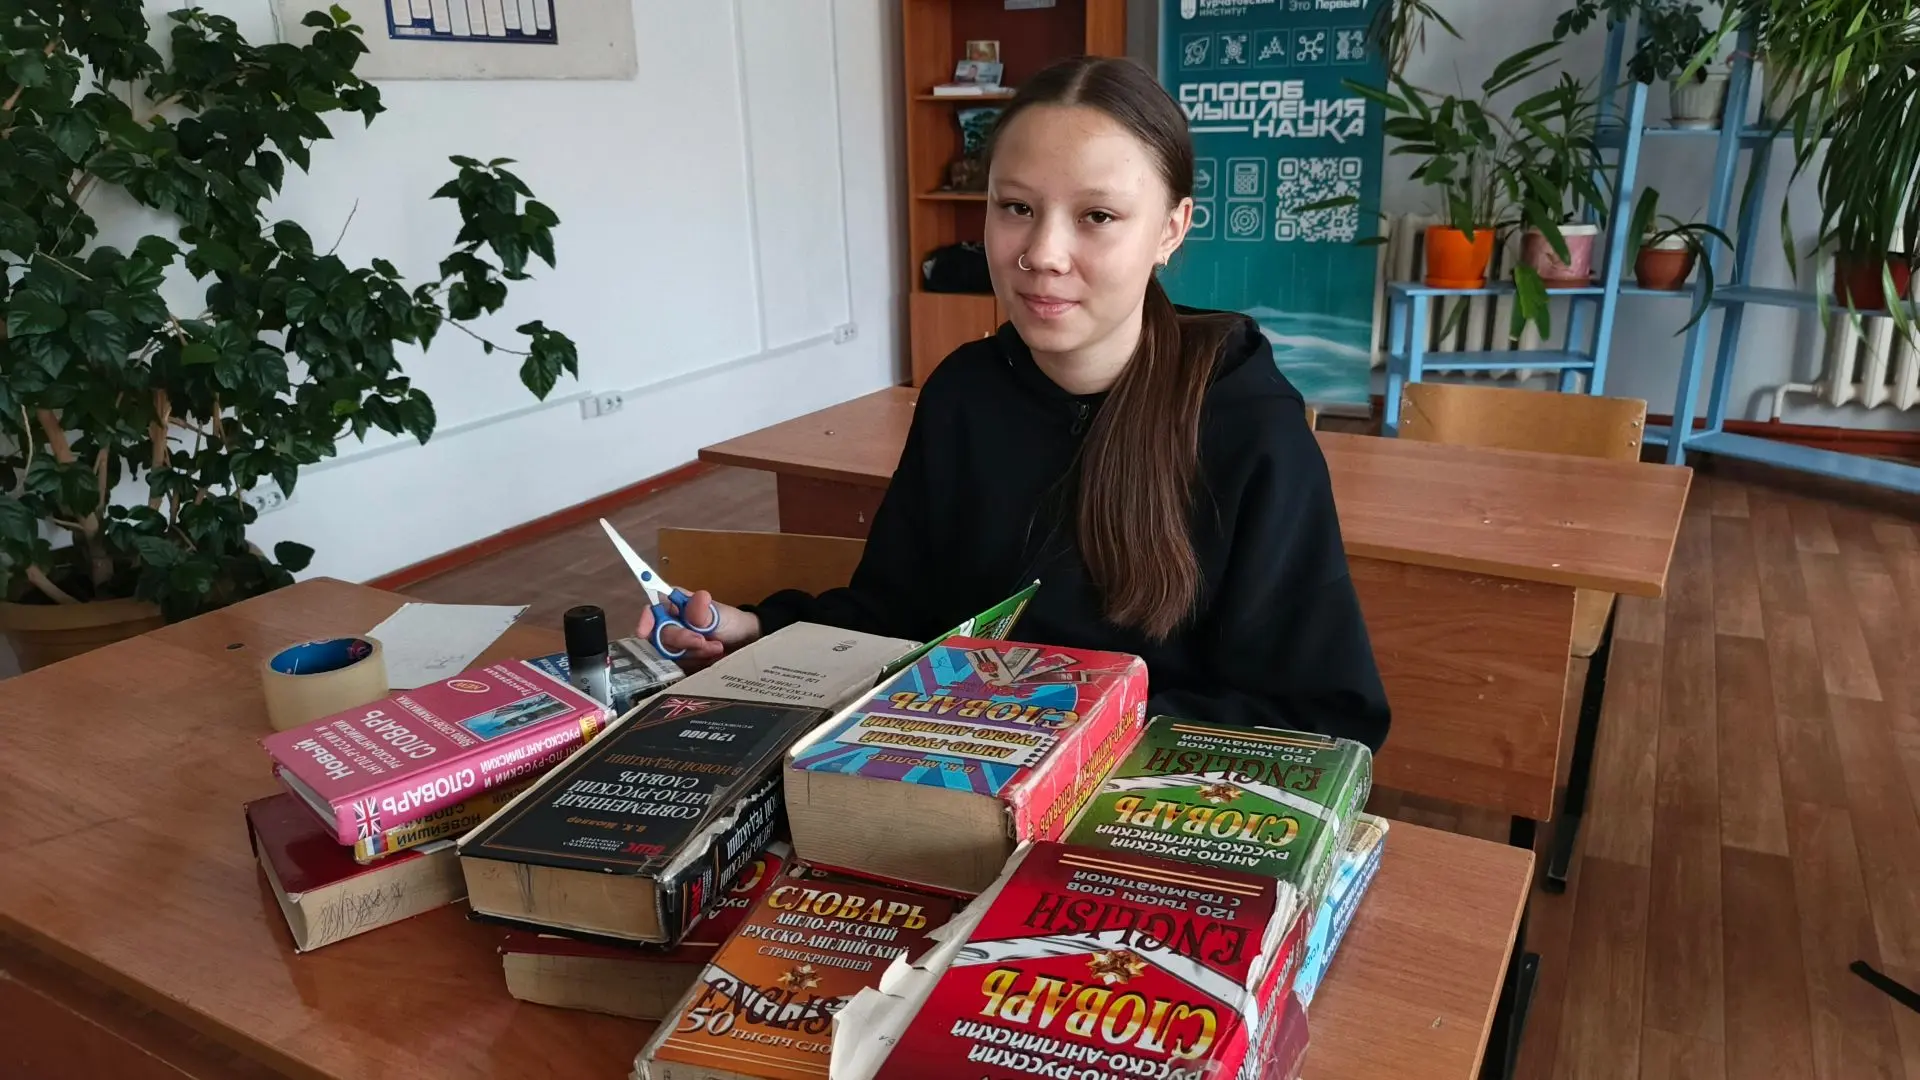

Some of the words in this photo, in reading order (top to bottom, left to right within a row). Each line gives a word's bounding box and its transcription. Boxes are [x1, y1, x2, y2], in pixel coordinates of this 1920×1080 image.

[1179, 80, 1304, 102] СПОСОБ
[1180, 98, 1366, 121] МЫШЛЕНИЯ
[1253, 118, 1365, 143] НАУКА
[887, 690, 1080, 731] СЛОВАРЬ
[331, 719, 406, 769] РУССКО-АНГЛИЙСКИЙ
[360, 709, 437, 759] СЛОВАРЬ
[679, 728, 707, 741] 000
[707, 730, 736, 743] 120
[858, 730, 1020, 759] АНГЛО-РУССКИЙ
[860, 715, 1044, 746] РУССКО-АНГЛИЙСКИЙ
[1180, 733, 1304, 755] грамматикой
[322, 728, 386, 775] АНГЛО-РУССКИЙ
[480, 727, 581, 774] РУССКО-АНГЛИЙСКИЙ
[1176, 740, 1218, 752] слов
[1220, 745, 1276, 763] тысяч
[1280, 753, 1313, 764] 120
[604, 752, 677, 771] РЕДАКЦИИ
[866, 752, 942, 770] МЮЛЛЕР
[1142, 747, 1326, 791] ENGLISH
[382, 768, 475, 816] СЛОВАРЬ
[484, 778, 492, 788] И
[568, 780, 713, 804] АНГЛО-РУССКИЙ
[619, 771, 701, 789] СЛОВАРЬ
[551, 793, 701, 820] СОВРЕМЕННЫЙ
[1040, 784, 1073, 835] СЛОВАРЬ
[1113, 794, 1300, 847] СЛОВАРЬ
[397, 812, 482, 846] НОВЕЙШИЙ
[1094, 823, 1290, 861] РУССКО-АНГЛИЙСКИЙ
[1109, 837, 1261, 868] АНГЛО-РУССКИЙ
[1066, 881, 1114, 899] слов
[1072, 870, 1224, 905] грамматикой
[1121, 889, 1188, 912] тысяч
[767, 885, 928, 931] СЛОВАРЬ
[1196, 902, 1237, 921] 120
[1228, 898, 1242, 907] с
[773, 911, 900, 942] АНГЛО-РУССКИЙ
[1024, 890, 1254, 967] ENGLISH
[687, 977, 848, 1034] ENGLIS
[979, 968, 1218, 1061] СЛОВАРЬ
[676, 1006, 736, 1037] 50
[795, 1037, 832, 1055] СЛО
